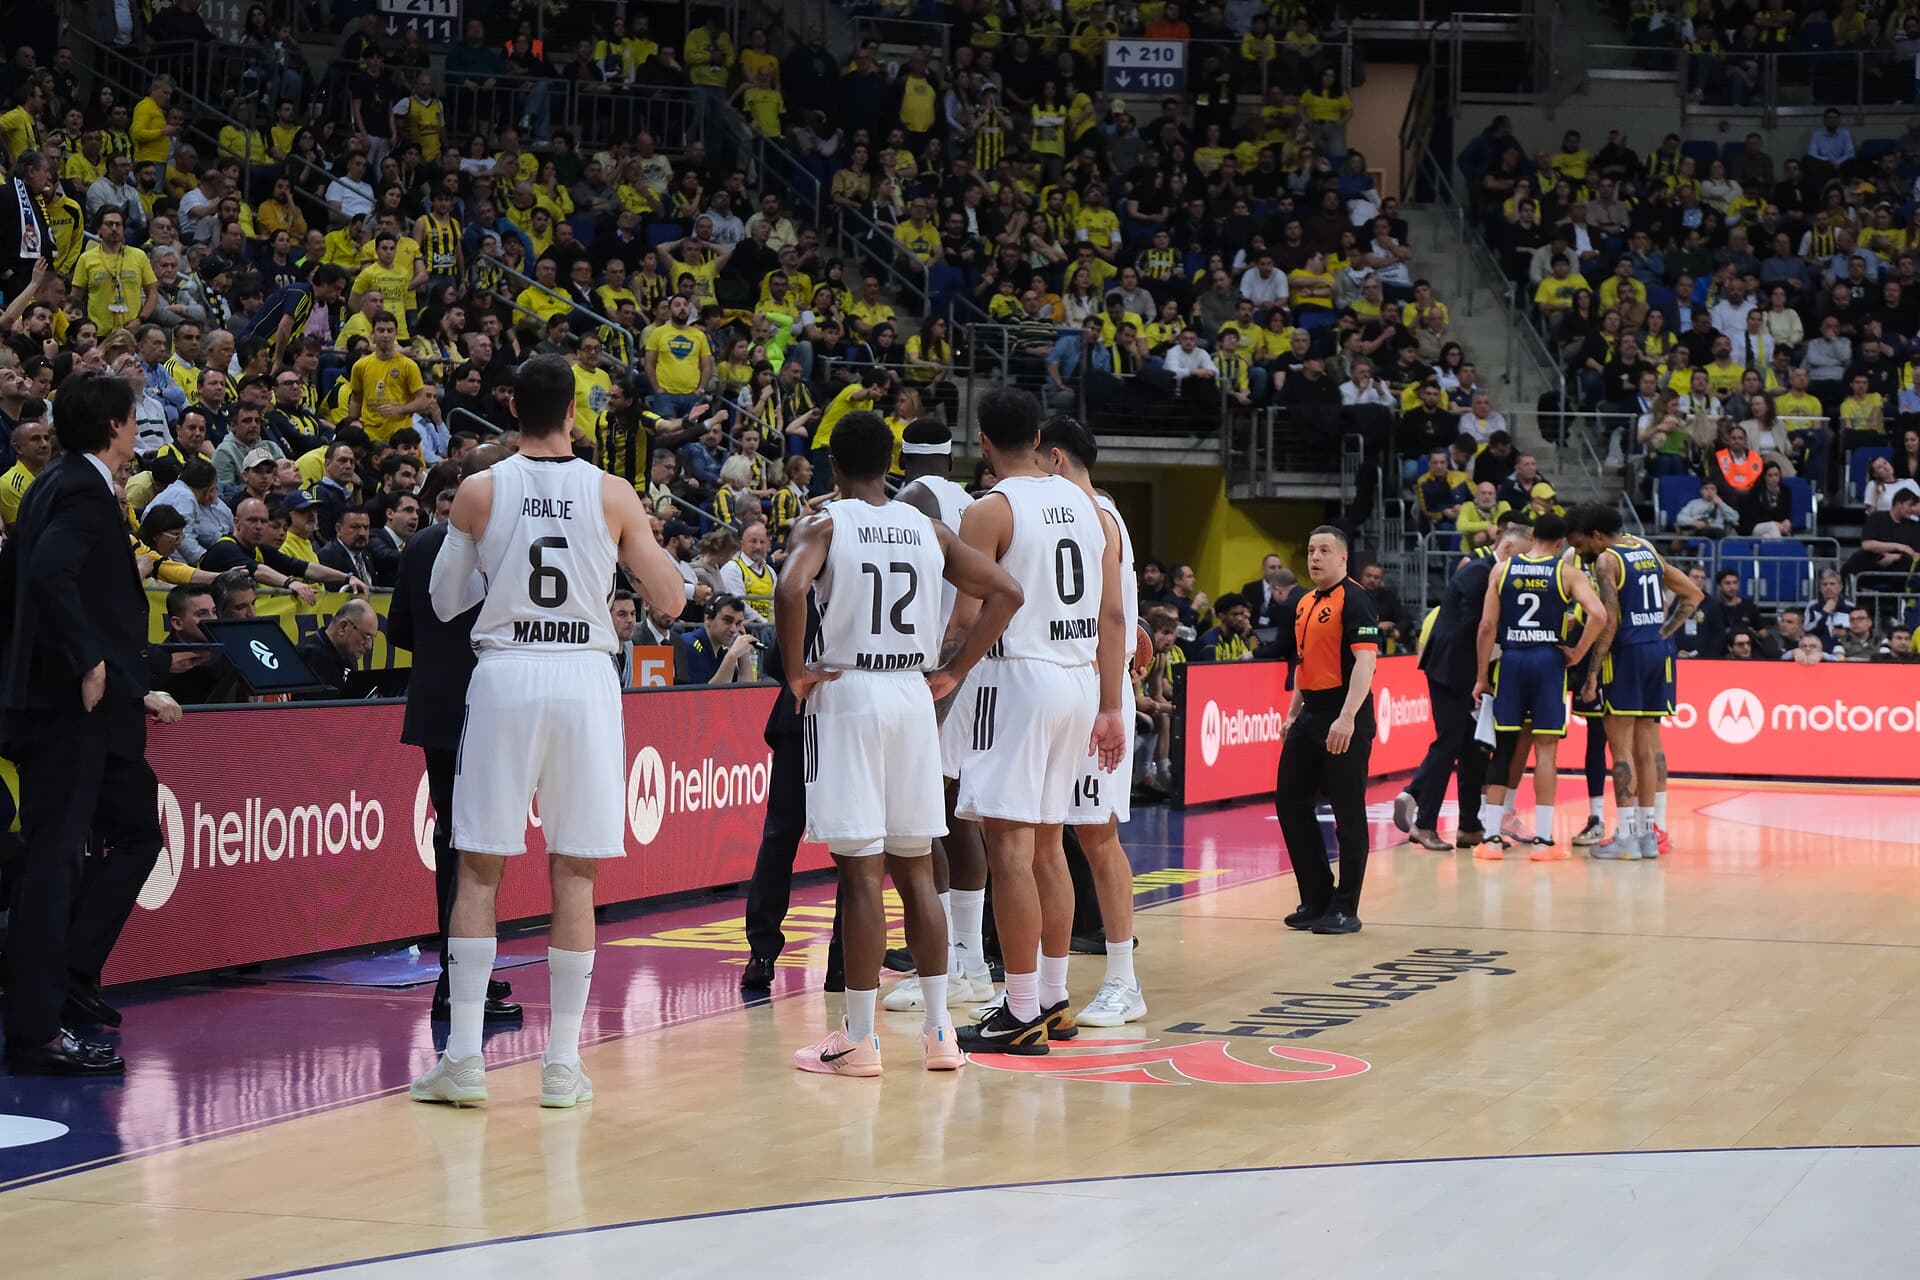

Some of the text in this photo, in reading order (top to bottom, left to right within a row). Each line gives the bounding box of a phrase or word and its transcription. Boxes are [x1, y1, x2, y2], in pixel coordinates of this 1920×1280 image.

[1140, 48, 1174, 61] 210
[1140, 72, 1174, 87] 110
[522, 498, 573, 520] ABALDE
[1042, 506, 1075, 525] LYLES
[858, 527, 921, 546] MALEDON
[529, 536, 568, 608] 6
[1055, 538, 1084, 605] 0
[1511, 564, 1544, 576] BALDWIN
[1640, 559, 1657, 570] MSC
[1525, 578, 1548, 589] MSC
[1638, 573, 1662, 609] 11
[862, 562, 917, 635] 12
[1517, 592, 1540, 627] 2
[512, 621, 590, 645] MADRID
[1050, 617, 1097, 641] MADRID
[641, 659, 666, 687] 5
[1221, 707, 1282, 746] hellomoto
[1074, 775, 1099, 807] 14
[193, 789, 384, 869] hellomoto
